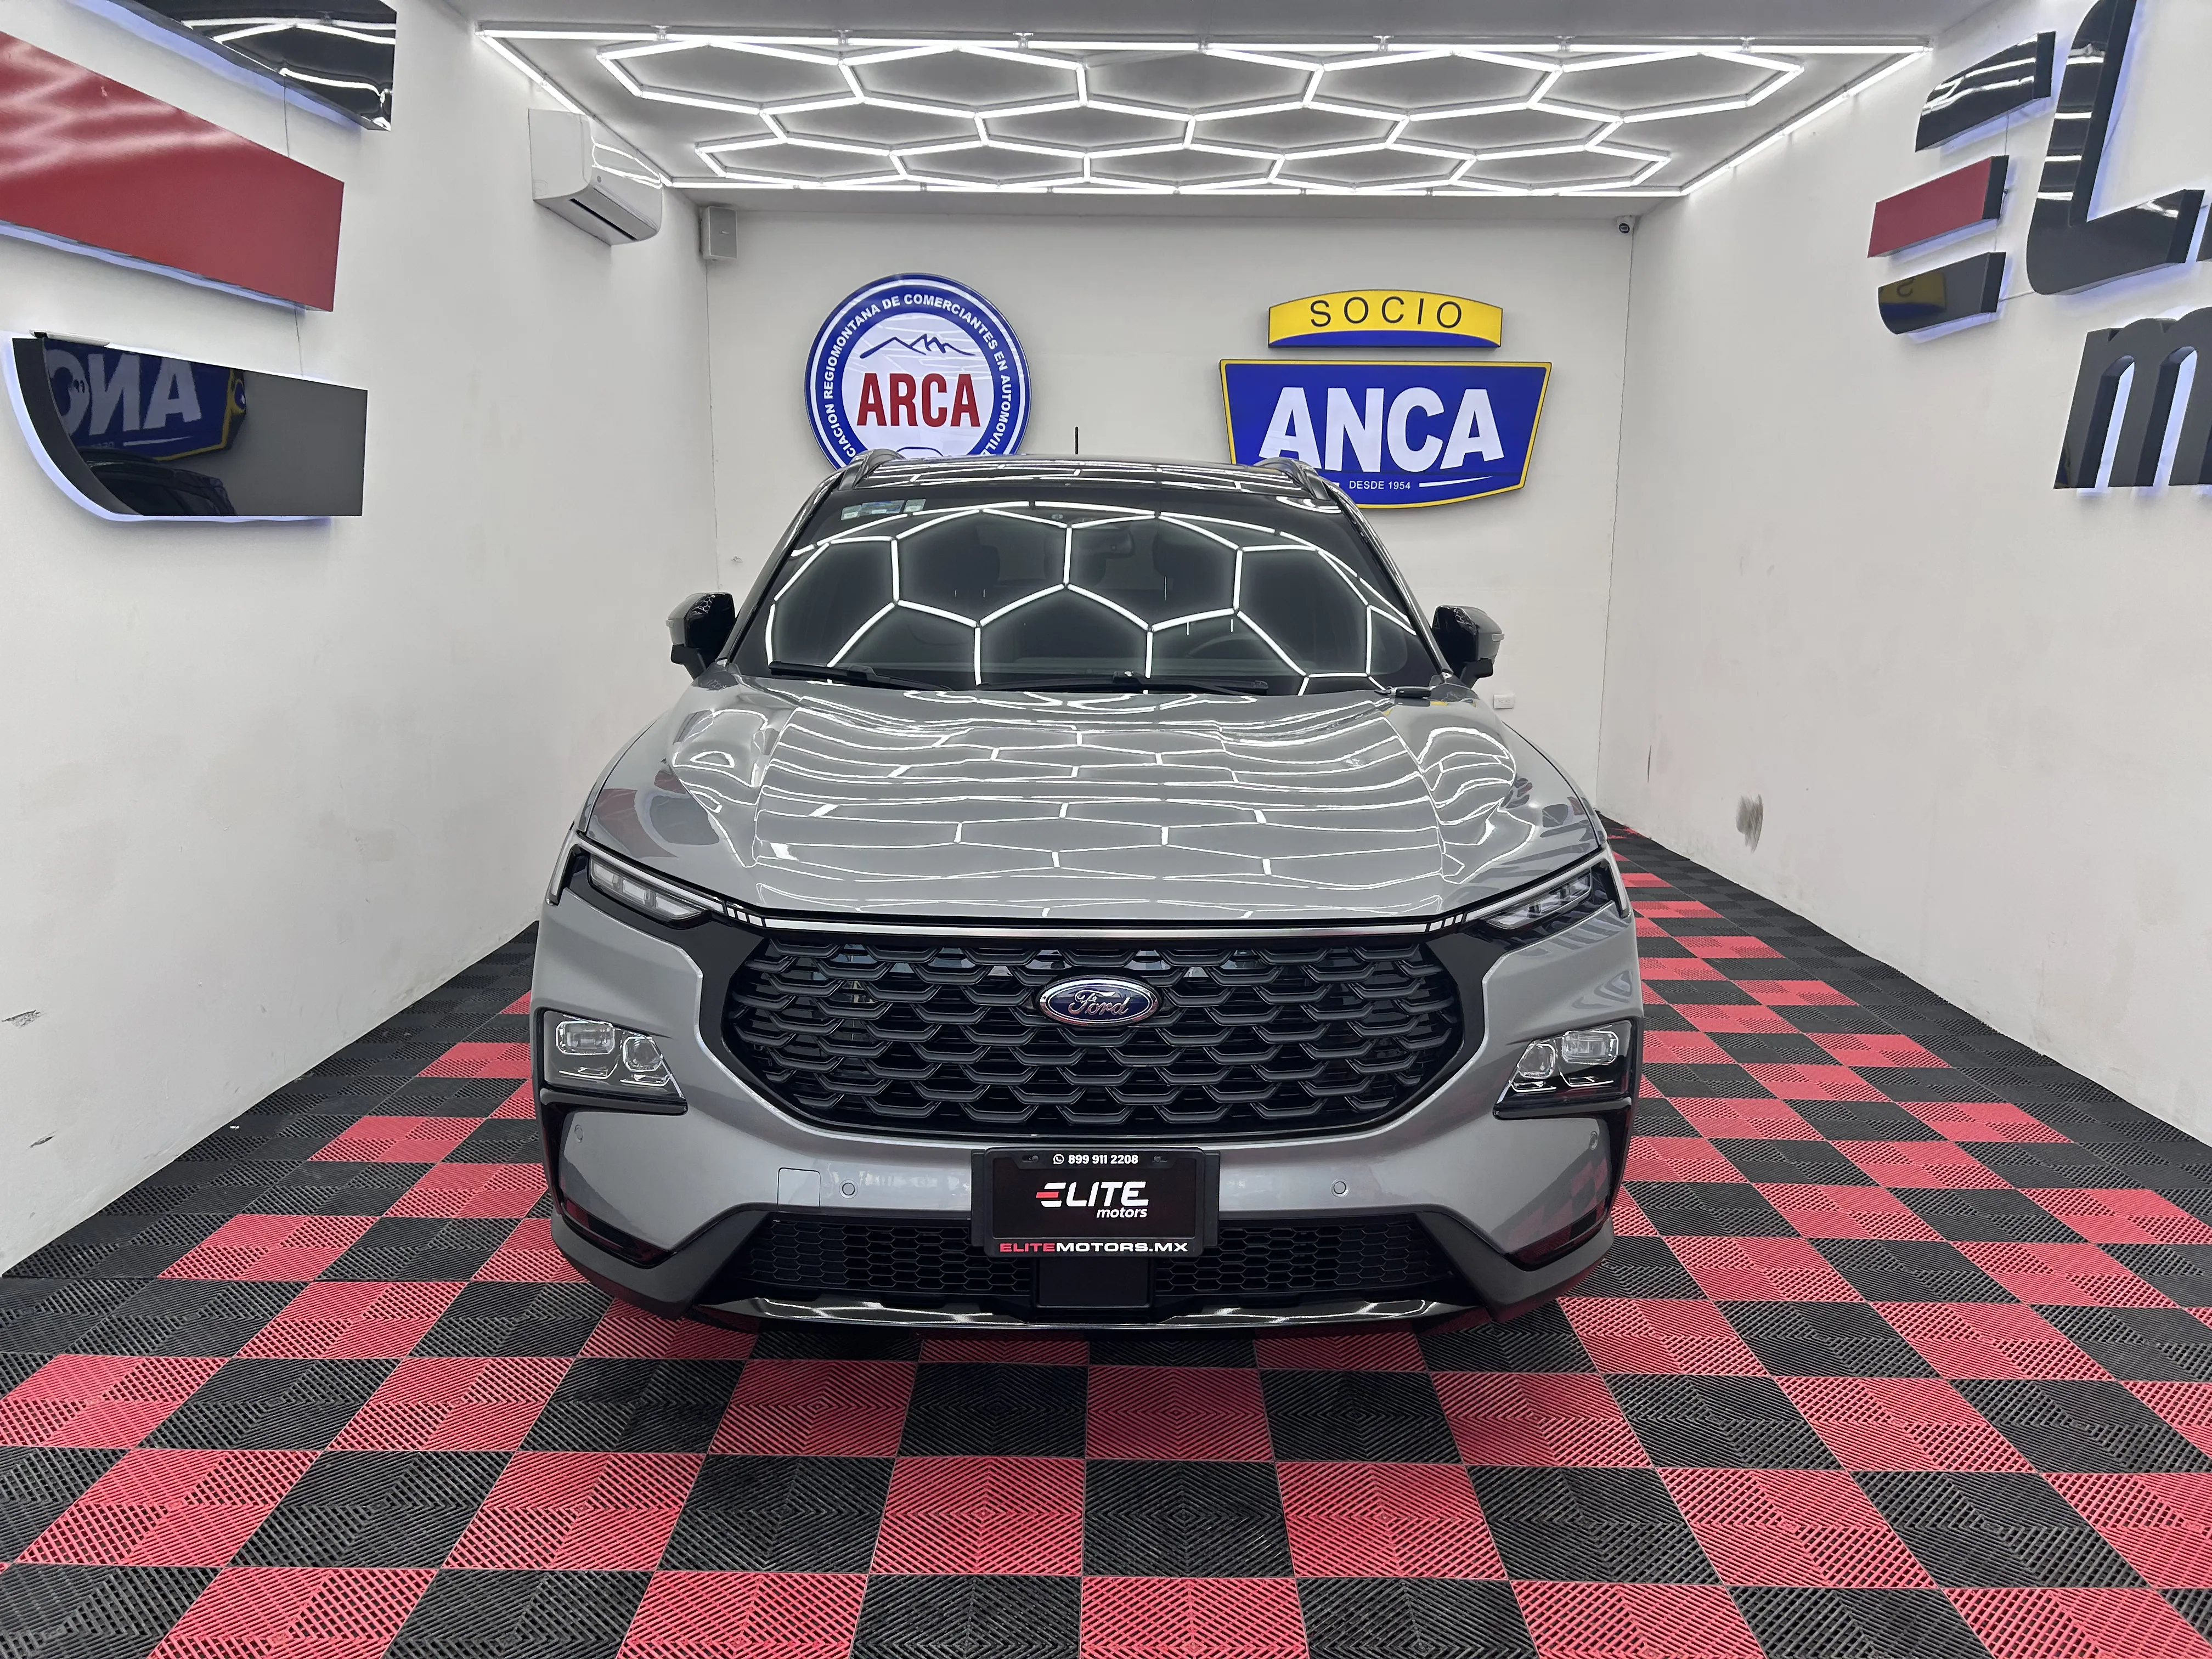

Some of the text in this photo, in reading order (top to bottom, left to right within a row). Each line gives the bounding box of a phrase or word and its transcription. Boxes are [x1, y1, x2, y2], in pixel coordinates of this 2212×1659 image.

[1310, 296, 1462, 328] SOCIO
[823, 304, 881, 399] REGIOMONTANA
[882, 296, 901, 310] DE
[904, 294, 998, 350] COMERCIANTES
[994, 351, 1008, 371] EN
[856, 373, 981, 427] ARCA
[1259, 387, 1505, 472] ANCA
[1348, 479, 1411, 490] DESDE 1954
[1068, 989, 1131, 1015] Ford
[1068, 1154, 1139, 1165] 899 911 2208
[1035, 1181, 1149, 1207] ELITE
[1096, 1207, 1148, 1218] motors
[1000, 1243, 1188, 1252] ELITEMOTORS.MX
